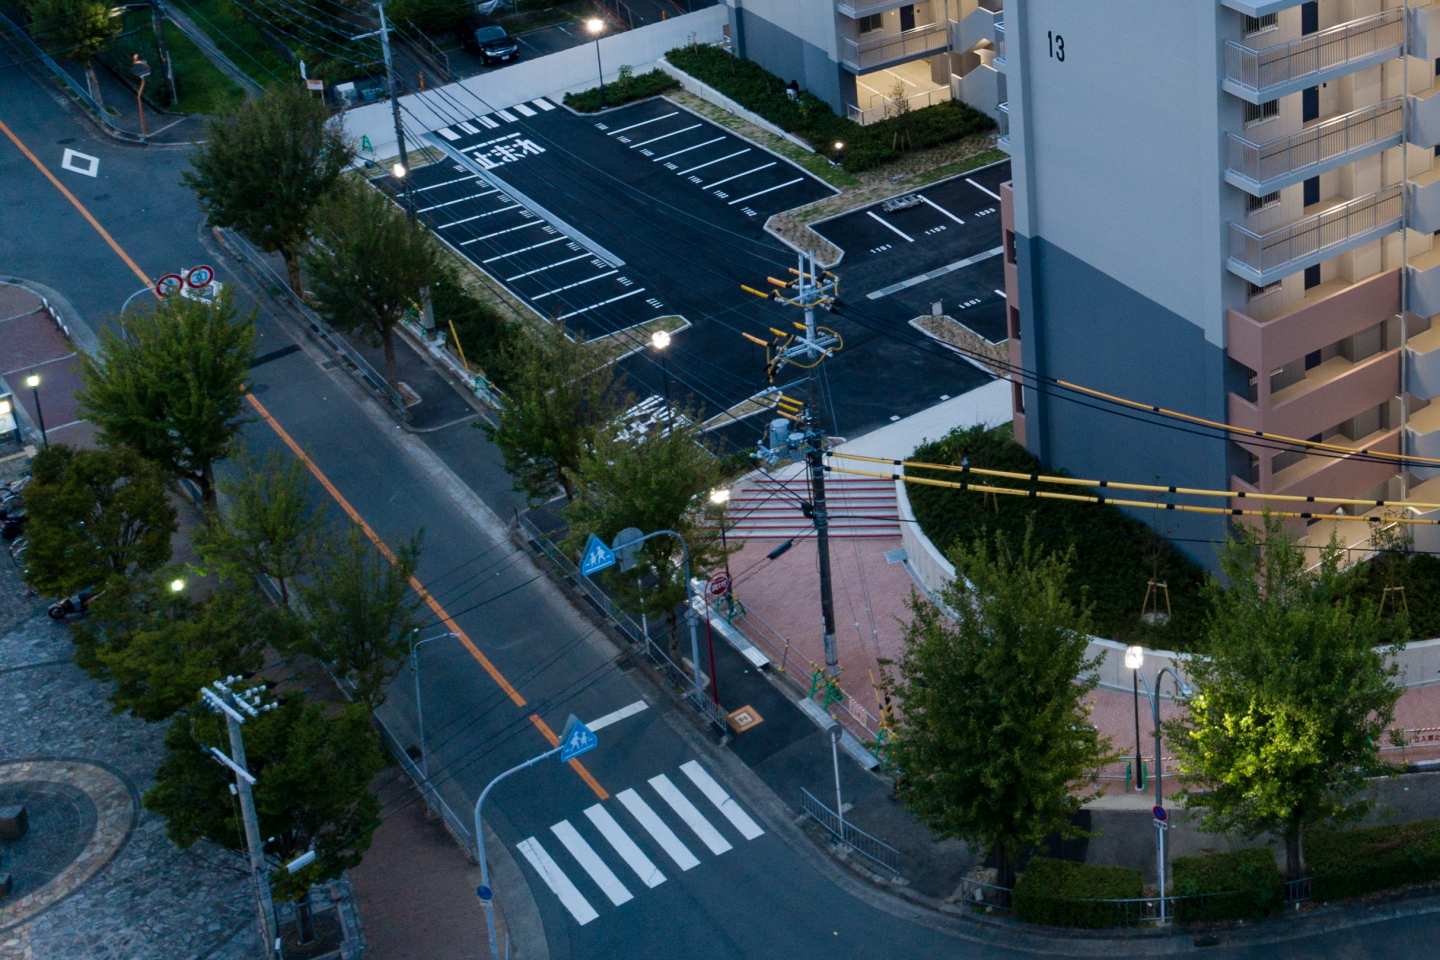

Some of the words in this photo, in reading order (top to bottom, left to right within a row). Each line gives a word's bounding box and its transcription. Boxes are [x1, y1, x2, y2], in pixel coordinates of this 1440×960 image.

[1047, 30, 1065, 62] 13
[472, 138, 547, 170] 止まれ
[192, 270, 208, 284] 30
[645, 297, 664, 309] 1117
